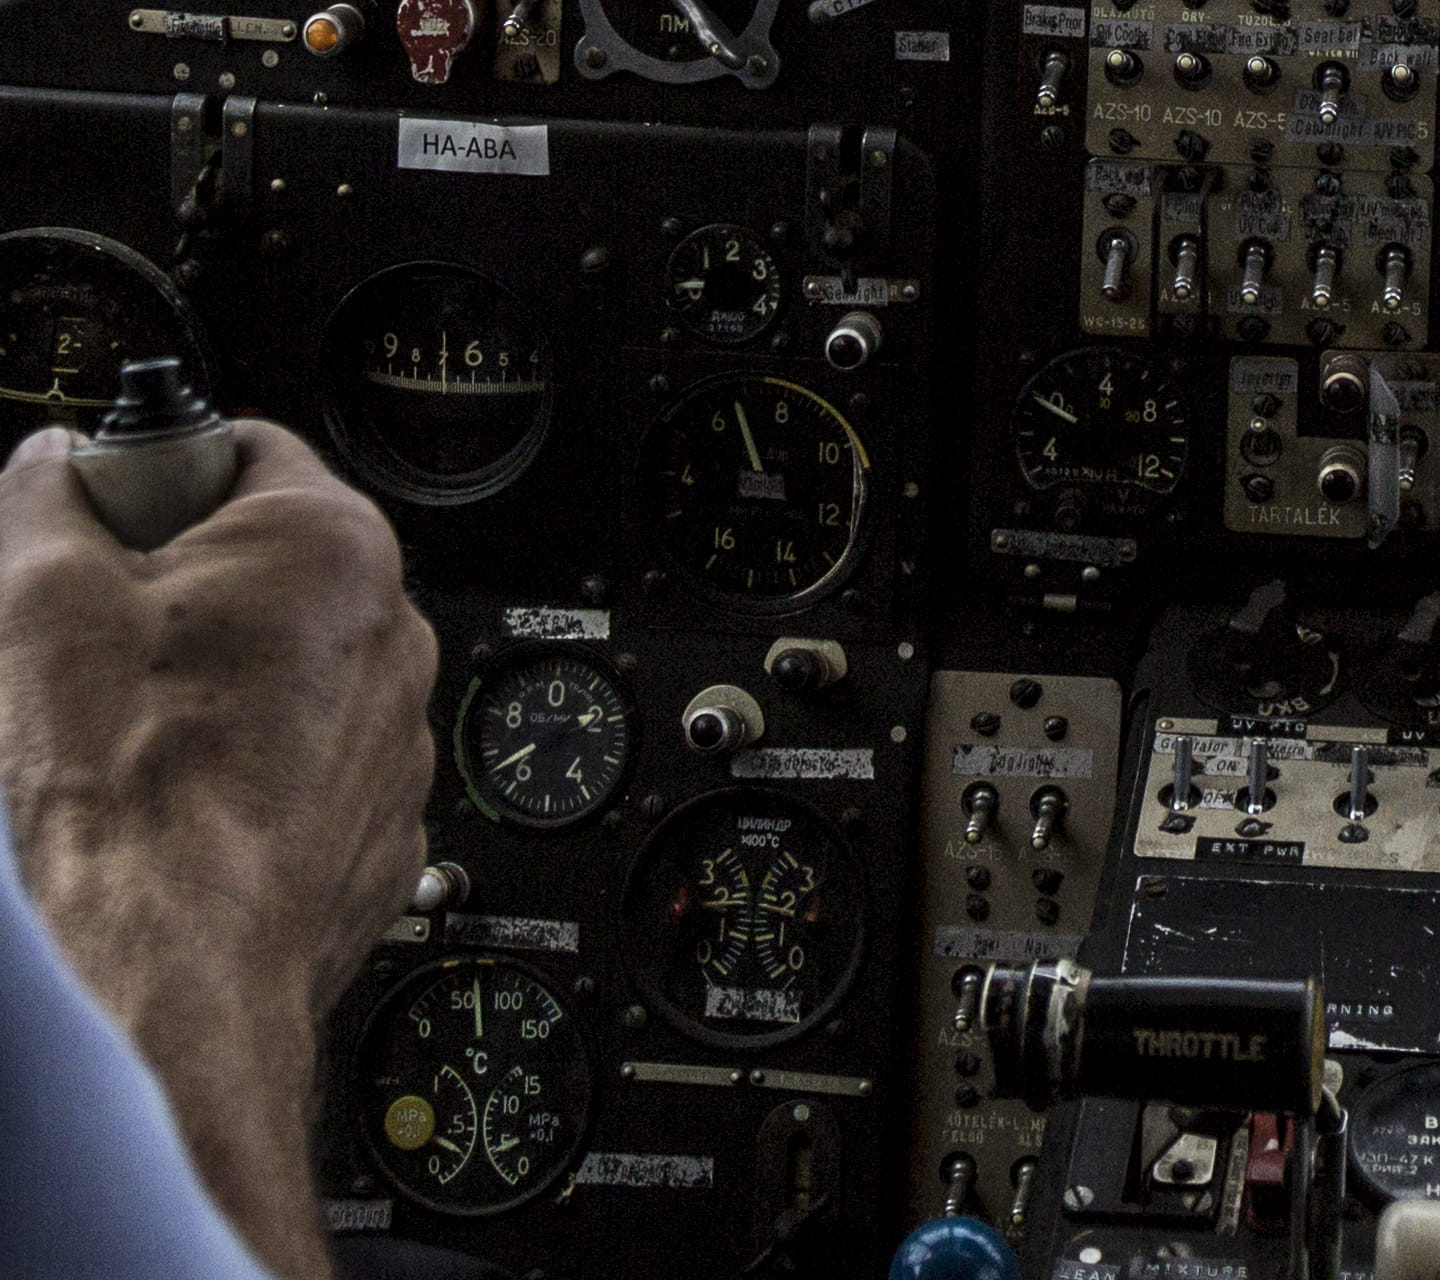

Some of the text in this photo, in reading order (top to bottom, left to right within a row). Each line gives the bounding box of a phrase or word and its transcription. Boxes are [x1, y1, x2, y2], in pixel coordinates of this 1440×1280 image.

[1093, 103, 1152, 122] AZS-10
[1162, 107, 1223, 127] AZS-10
[1233, 110, 1287, 131] AZS-5
[423, 132, 518, 161] HA-ABA
[725, 240, 741, 261] 2
[752, 258, 767, 281] 3
[1142, 398, 1158, 423] 8
[819, 442, 840, 464] 10
[1137, 453, 1161, 478] 12
[819, 503, 841, 526] 12
[1249, 503, 1341, 526] TARTALÉK
[714, 527, 736, 550] 16
[775, 540, 798, 563] 14
[548, 680, 565, 707] 0
[506, 701, 522, 728] 8
[564, 756, 583, 784] 4
[1216, 760, 1240, 772] ON
[1211, 842, 1300, 856] EXT PWR
[451, 991, 474, 1011] 50
[493, 991, 523, 1011] 100
[521, 1019, 550, 1039] 150
[1133, 1027, 1266, 1062] THROTTLE
[524, 1075, 542, 1095] 15
[502, 1095, 520, 1114] 10
[396, 1107, 428, 1124] MPa
[528, 1113, 560, 1128] MPa
[1145, 1262, 1250, 1279] MIXTURE
